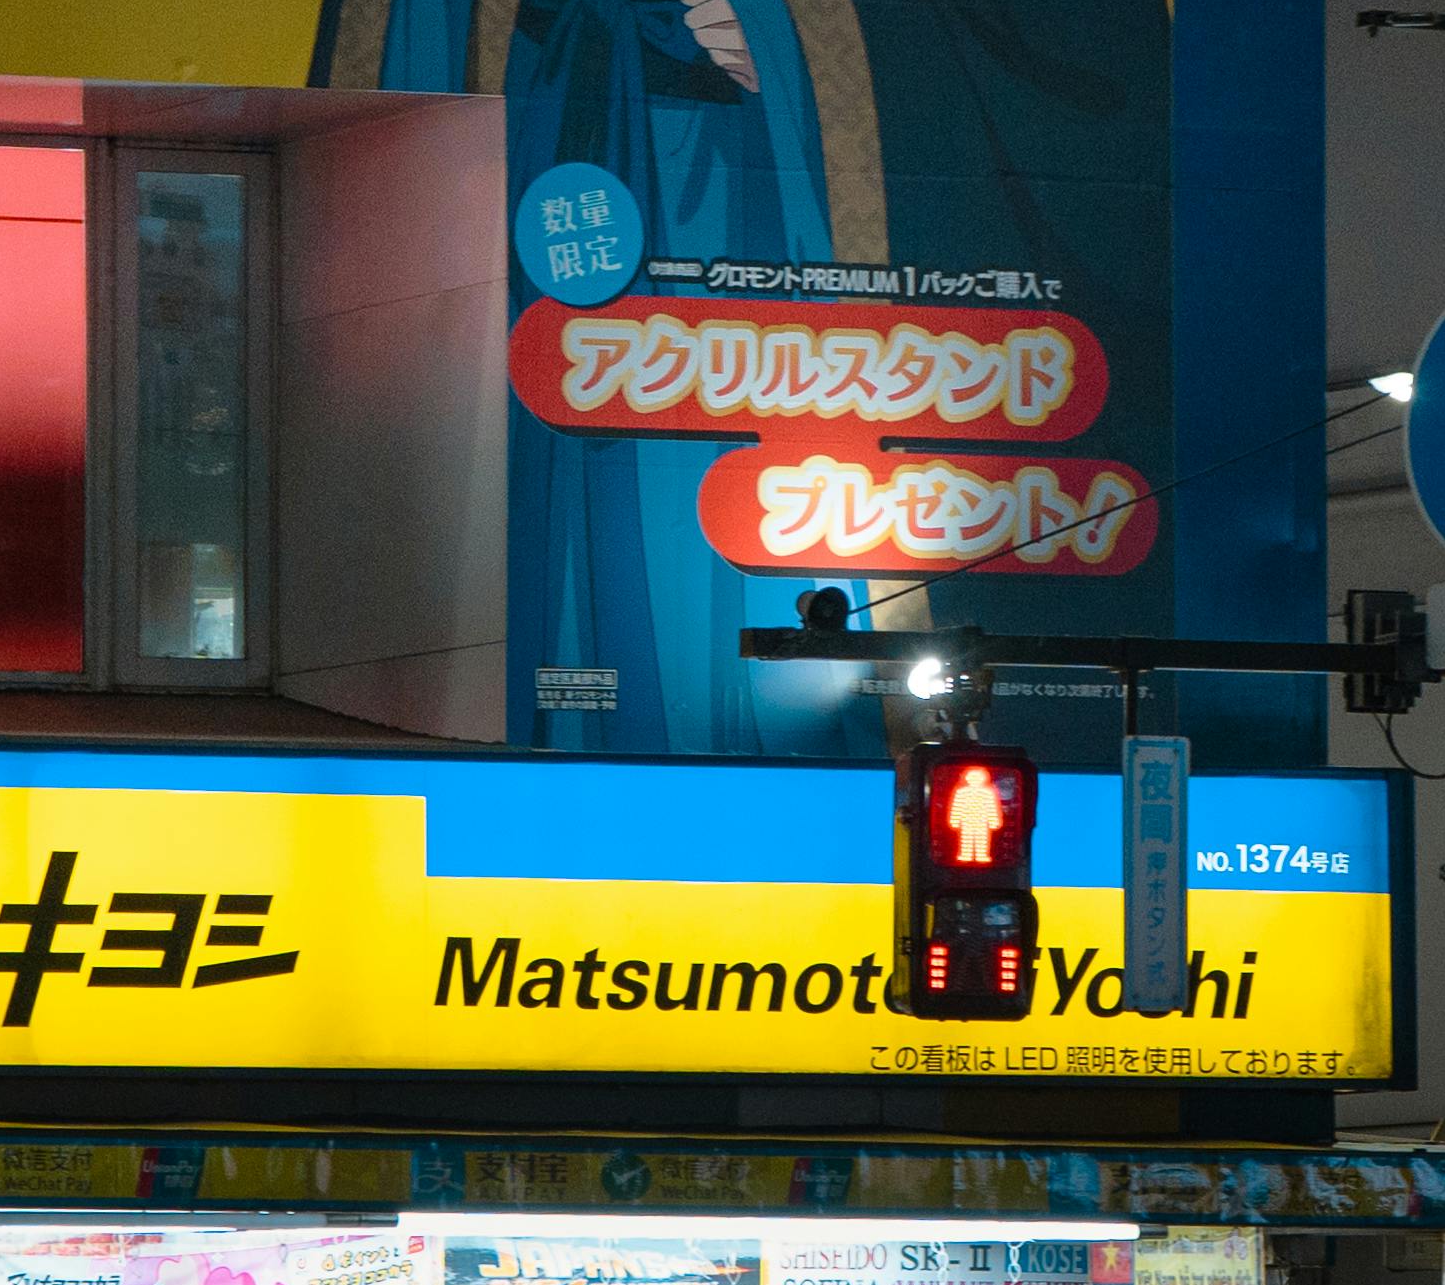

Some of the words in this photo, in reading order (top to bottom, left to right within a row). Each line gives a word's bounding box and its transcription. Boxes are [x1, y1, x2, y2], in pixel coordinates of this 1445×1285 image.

[541, 190, 612, 235] 数量
[548, 236, 622, 281] 限定
[568, 323, 1072, 420] アクリルスタンド
[870, 1045, 993, 1073] この看板は
[1004, 1047, 1058, 1071] LED
[1066, 1047, 1358, 1077] 照明を使用しております。
